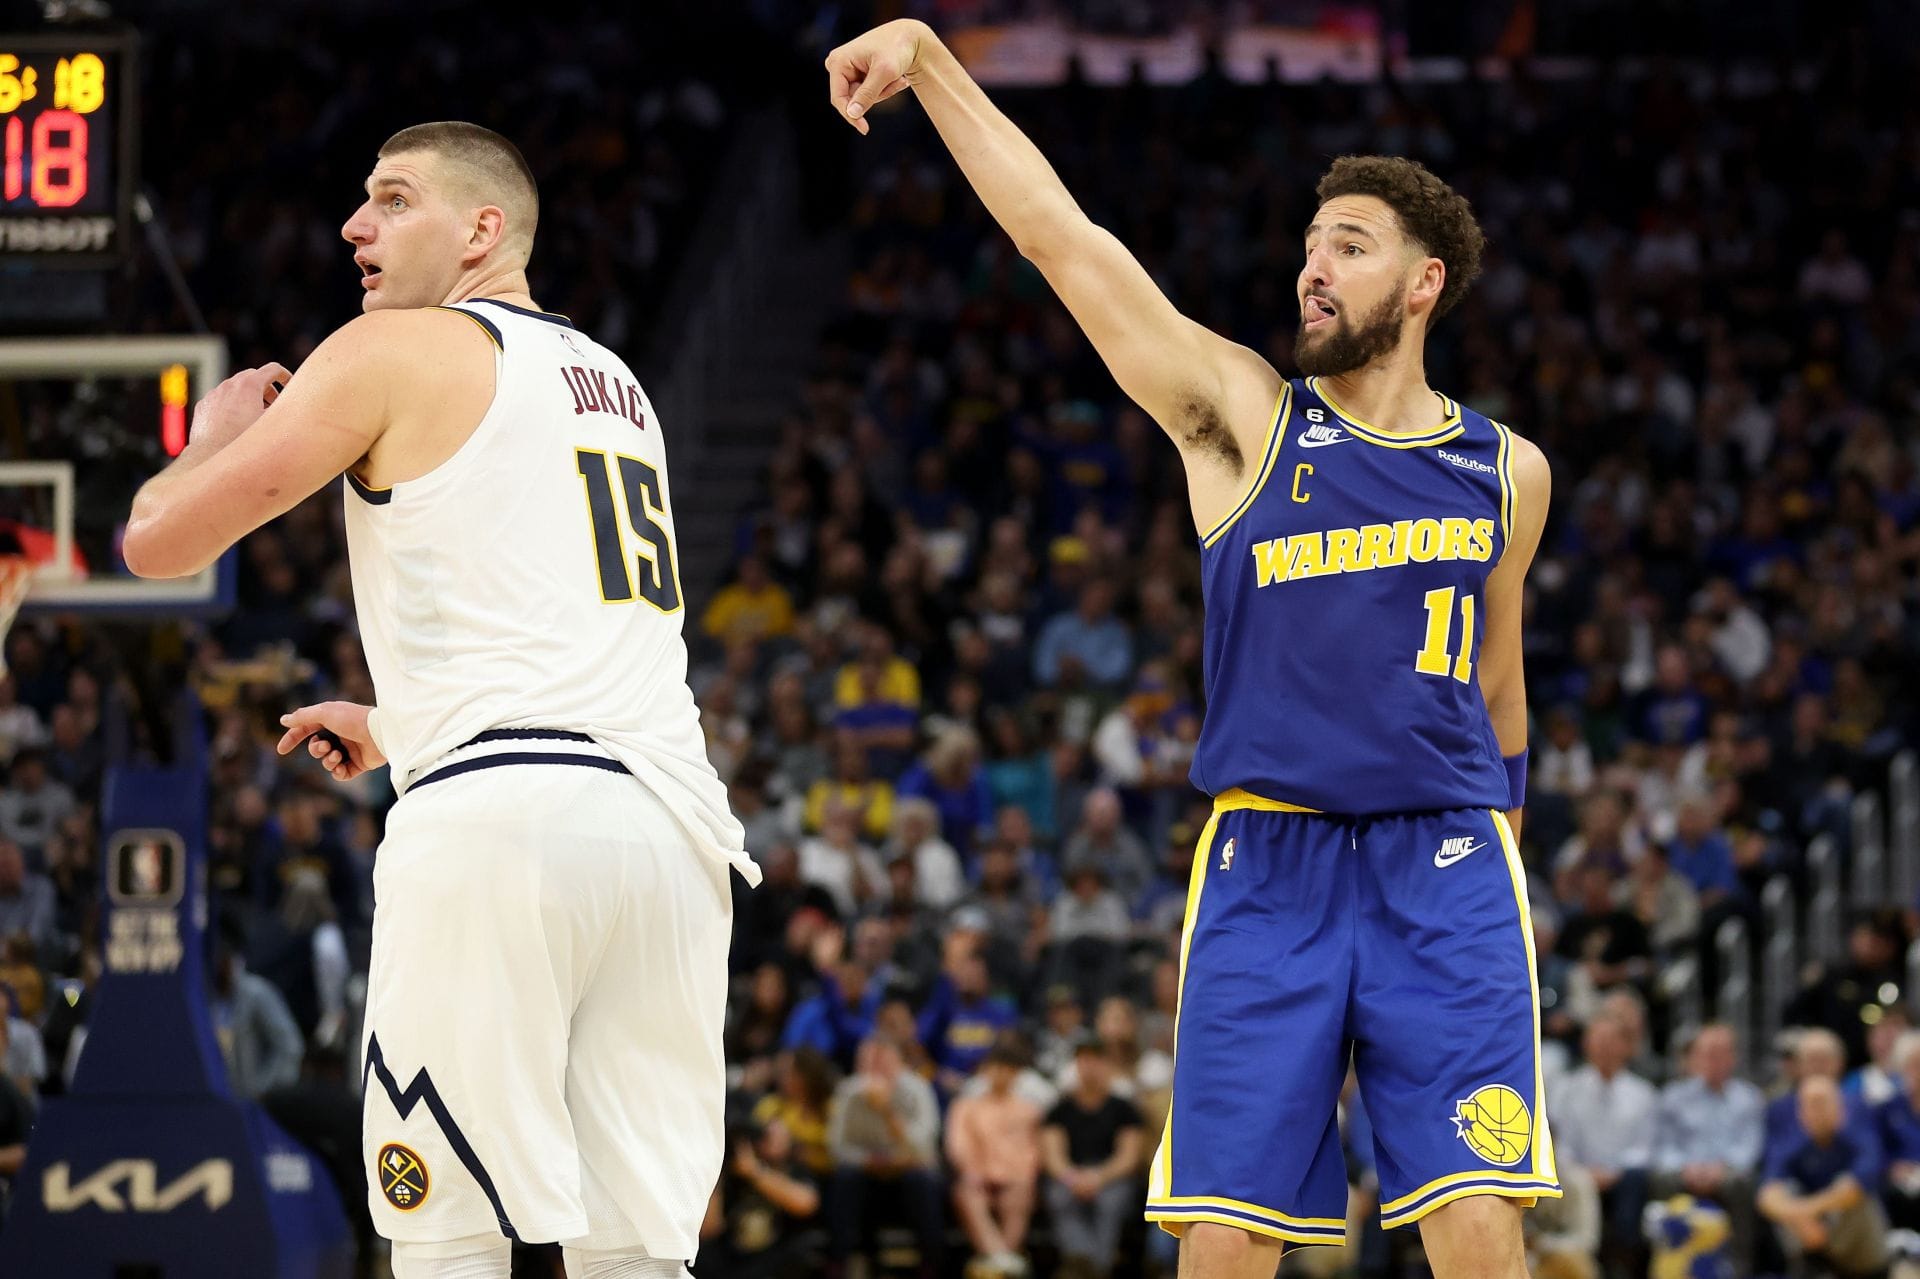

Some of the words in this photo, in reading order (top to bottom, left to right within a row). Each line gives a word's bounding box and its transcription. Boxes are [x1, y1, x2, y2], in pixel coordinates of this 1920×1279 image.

[4, 108, 88, 207] 18
[1305, 423, 1343, 441] NIKE
[1306, 408, 1325, 423] 6
[1291, 463, 1314, 503] C
[1437, 449, 1497, 475] Rakuten
[573, 446, 684, 616] 15
[1252, 518, 1495, 588] WARRIORS
[1415, 586, 1474, 685] 11
[1440, 836, 1475, 856] NIKE
[42, 1158, 234, 1212] KIA
